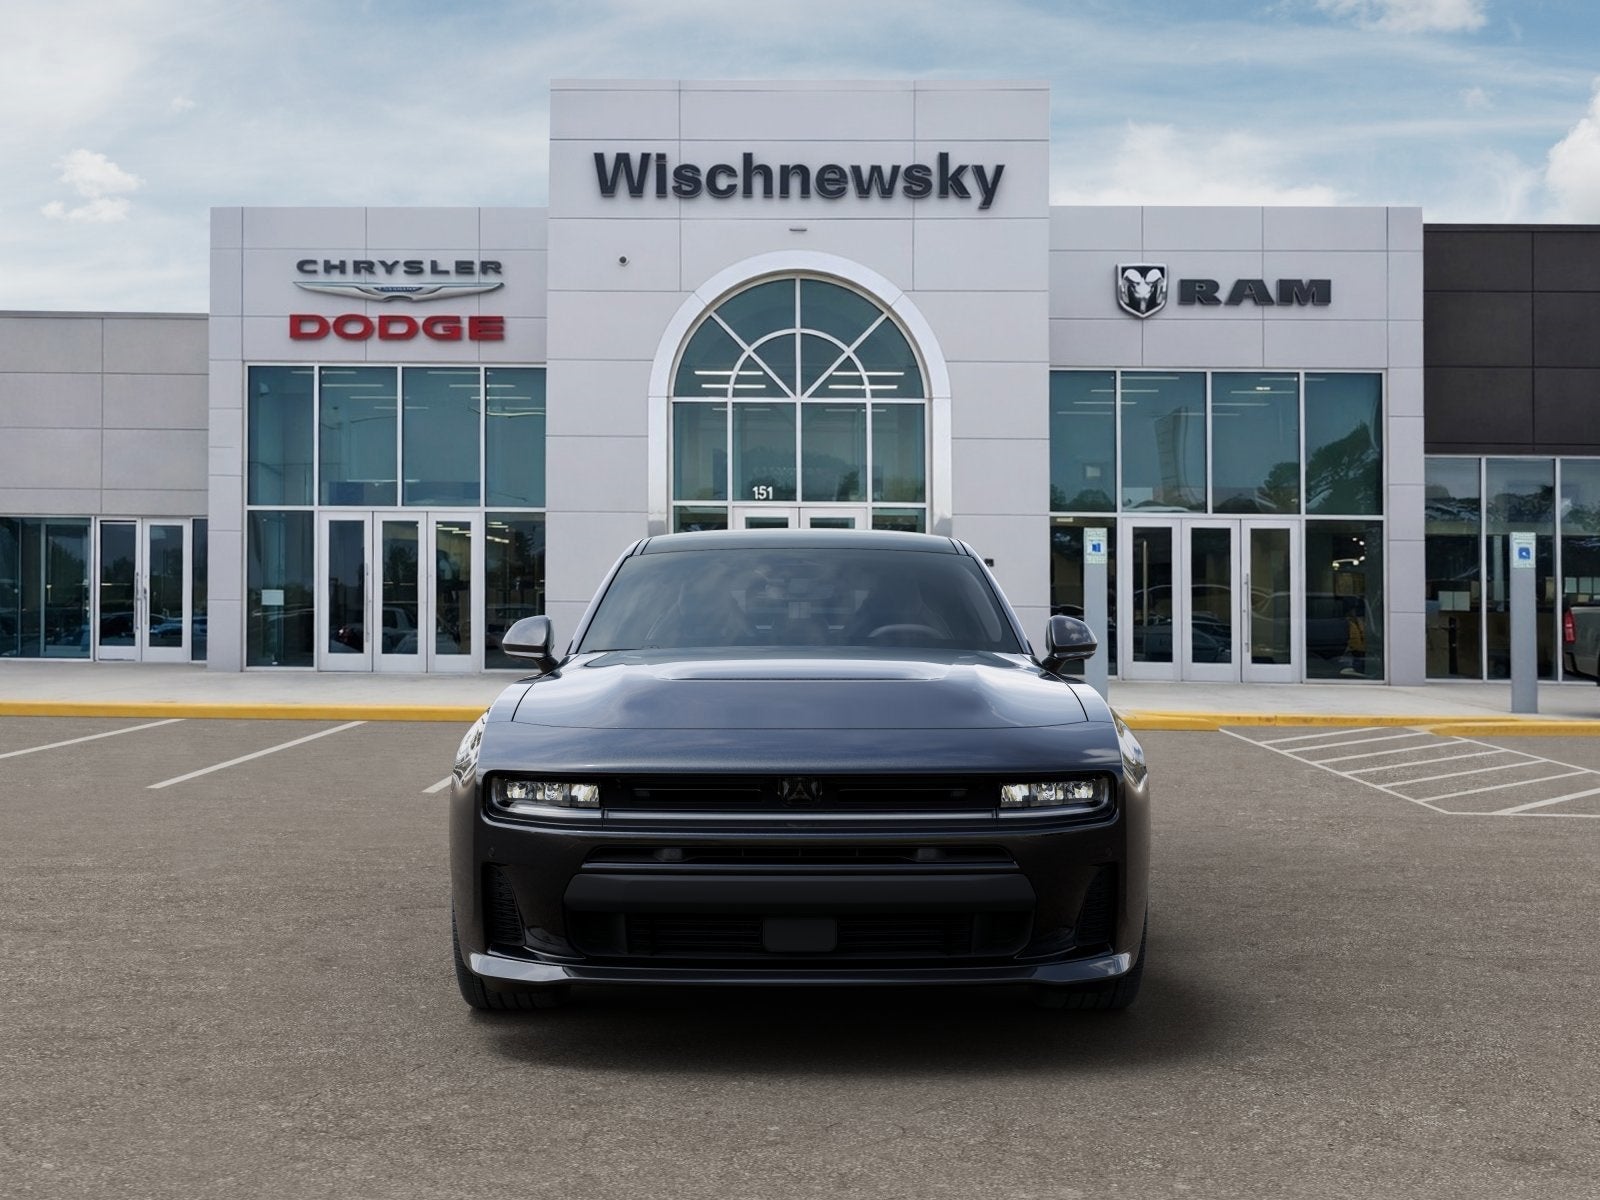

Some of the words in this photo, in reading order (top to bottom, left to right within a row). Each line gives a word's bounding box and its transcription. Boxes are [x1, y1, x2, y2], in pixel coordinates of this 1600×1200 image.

[593, 152, 1006, 210] Wischnewsky
[296, 259, 503, 275] CHRYSLER
[1177, 279, 1332, 306] RAM
[289, 314, 505, 341] DODGE
[752, 485, 774, 500] 151
